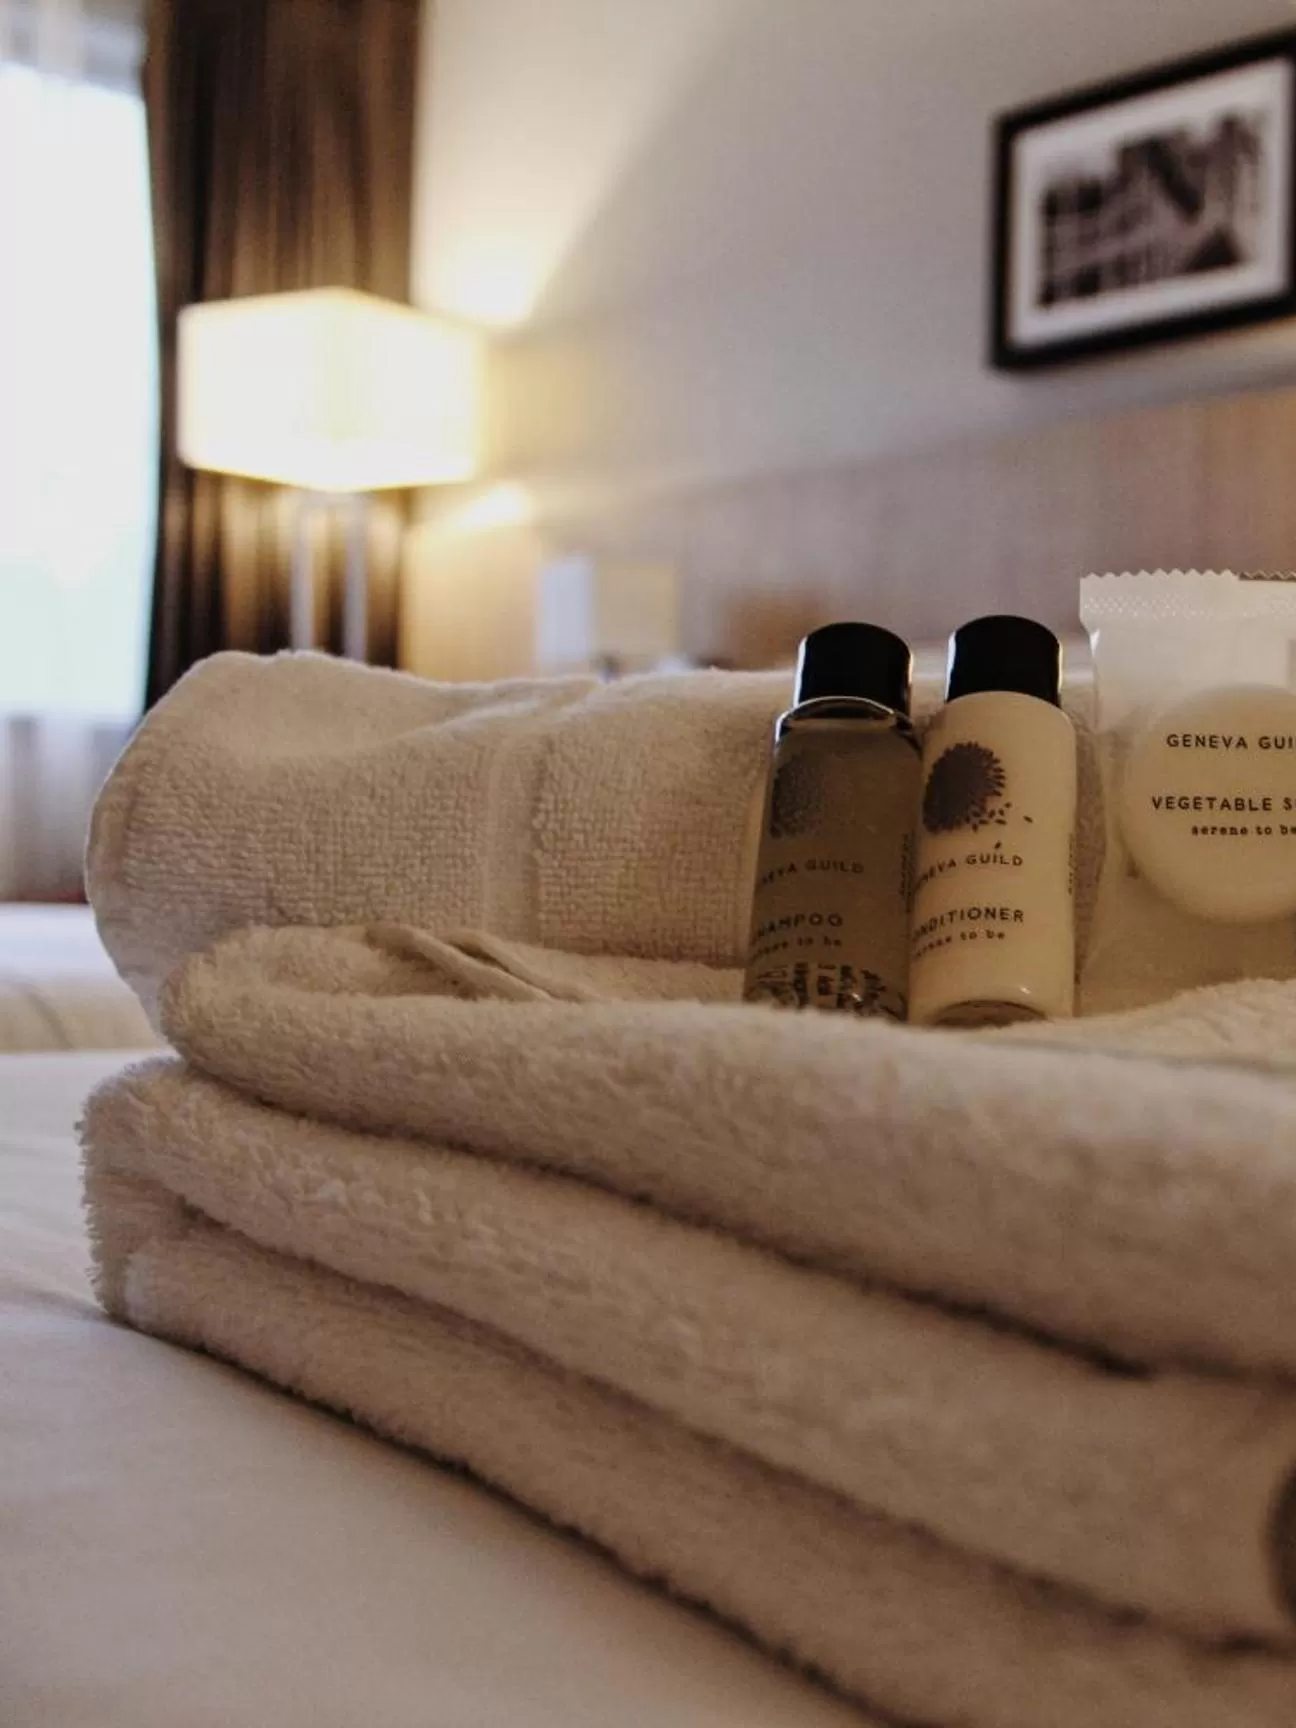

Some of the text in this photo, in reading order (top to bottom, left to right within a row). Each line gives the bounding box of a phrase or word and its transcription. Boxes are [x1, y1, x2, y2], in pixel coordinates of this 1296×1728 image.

[1166, 733, 1249, 750] GENEVA
[1151, 796, 1273, 812] VEGETABLE
[1191, 824, 1249, 836] serene
[1256, 825, 1273, 836] to
[965, 853, 1024, 867] GUILD
